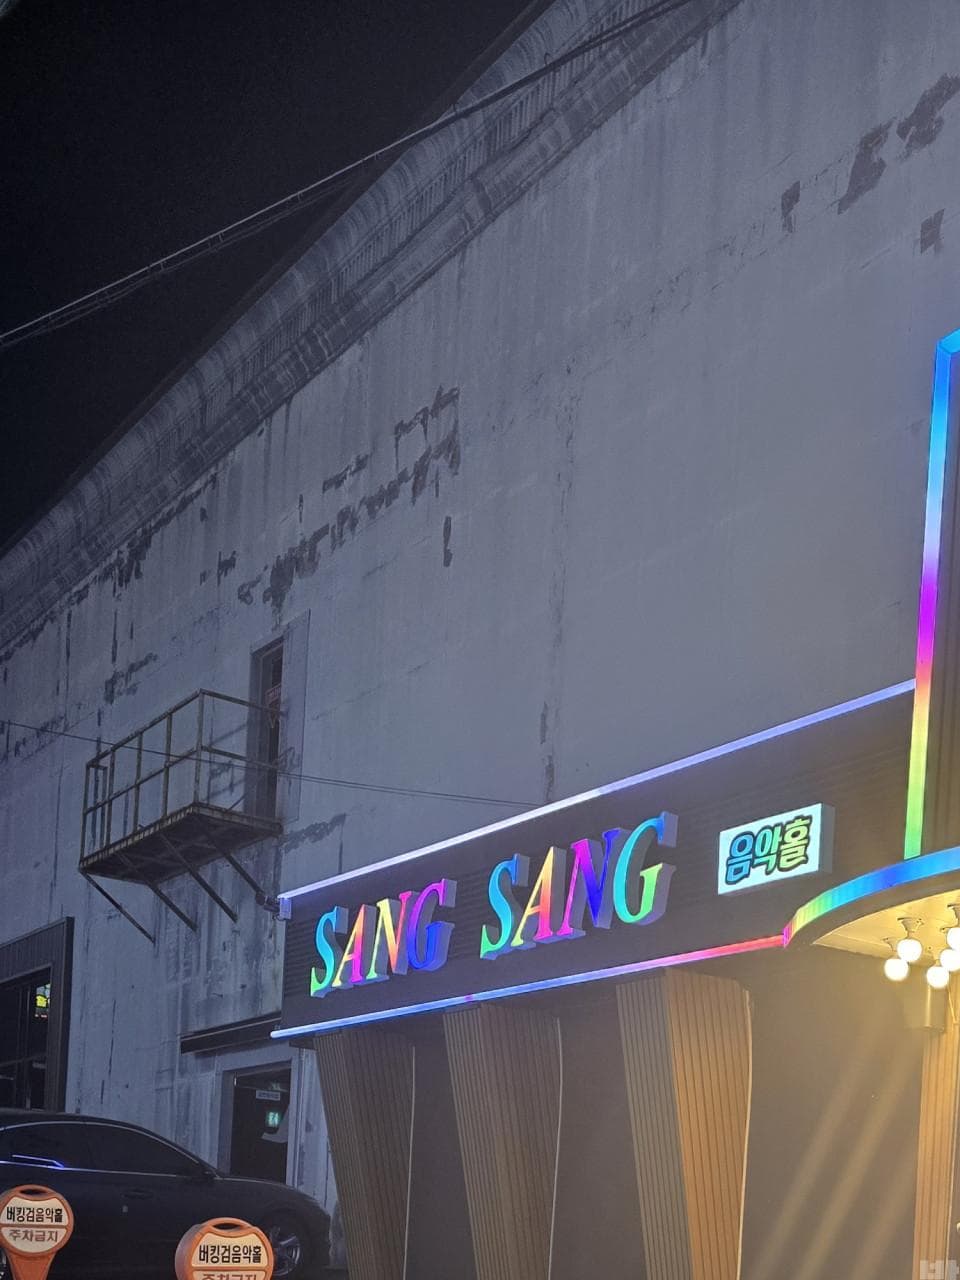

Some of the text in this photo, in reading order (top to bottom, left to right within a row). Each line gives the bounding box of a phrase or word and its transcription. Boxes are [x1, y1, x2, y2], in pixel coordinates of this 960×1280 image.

[725, 814, 812, 885] 음악홀
[310, 812, 668, 997] SANG SANG
[6, 1206, 63, 1223] 버킹검음악홀
[9, 1229, 58, 1243] 주차금지
[198, 1244, 262, 1264] 버킹검음악홀
